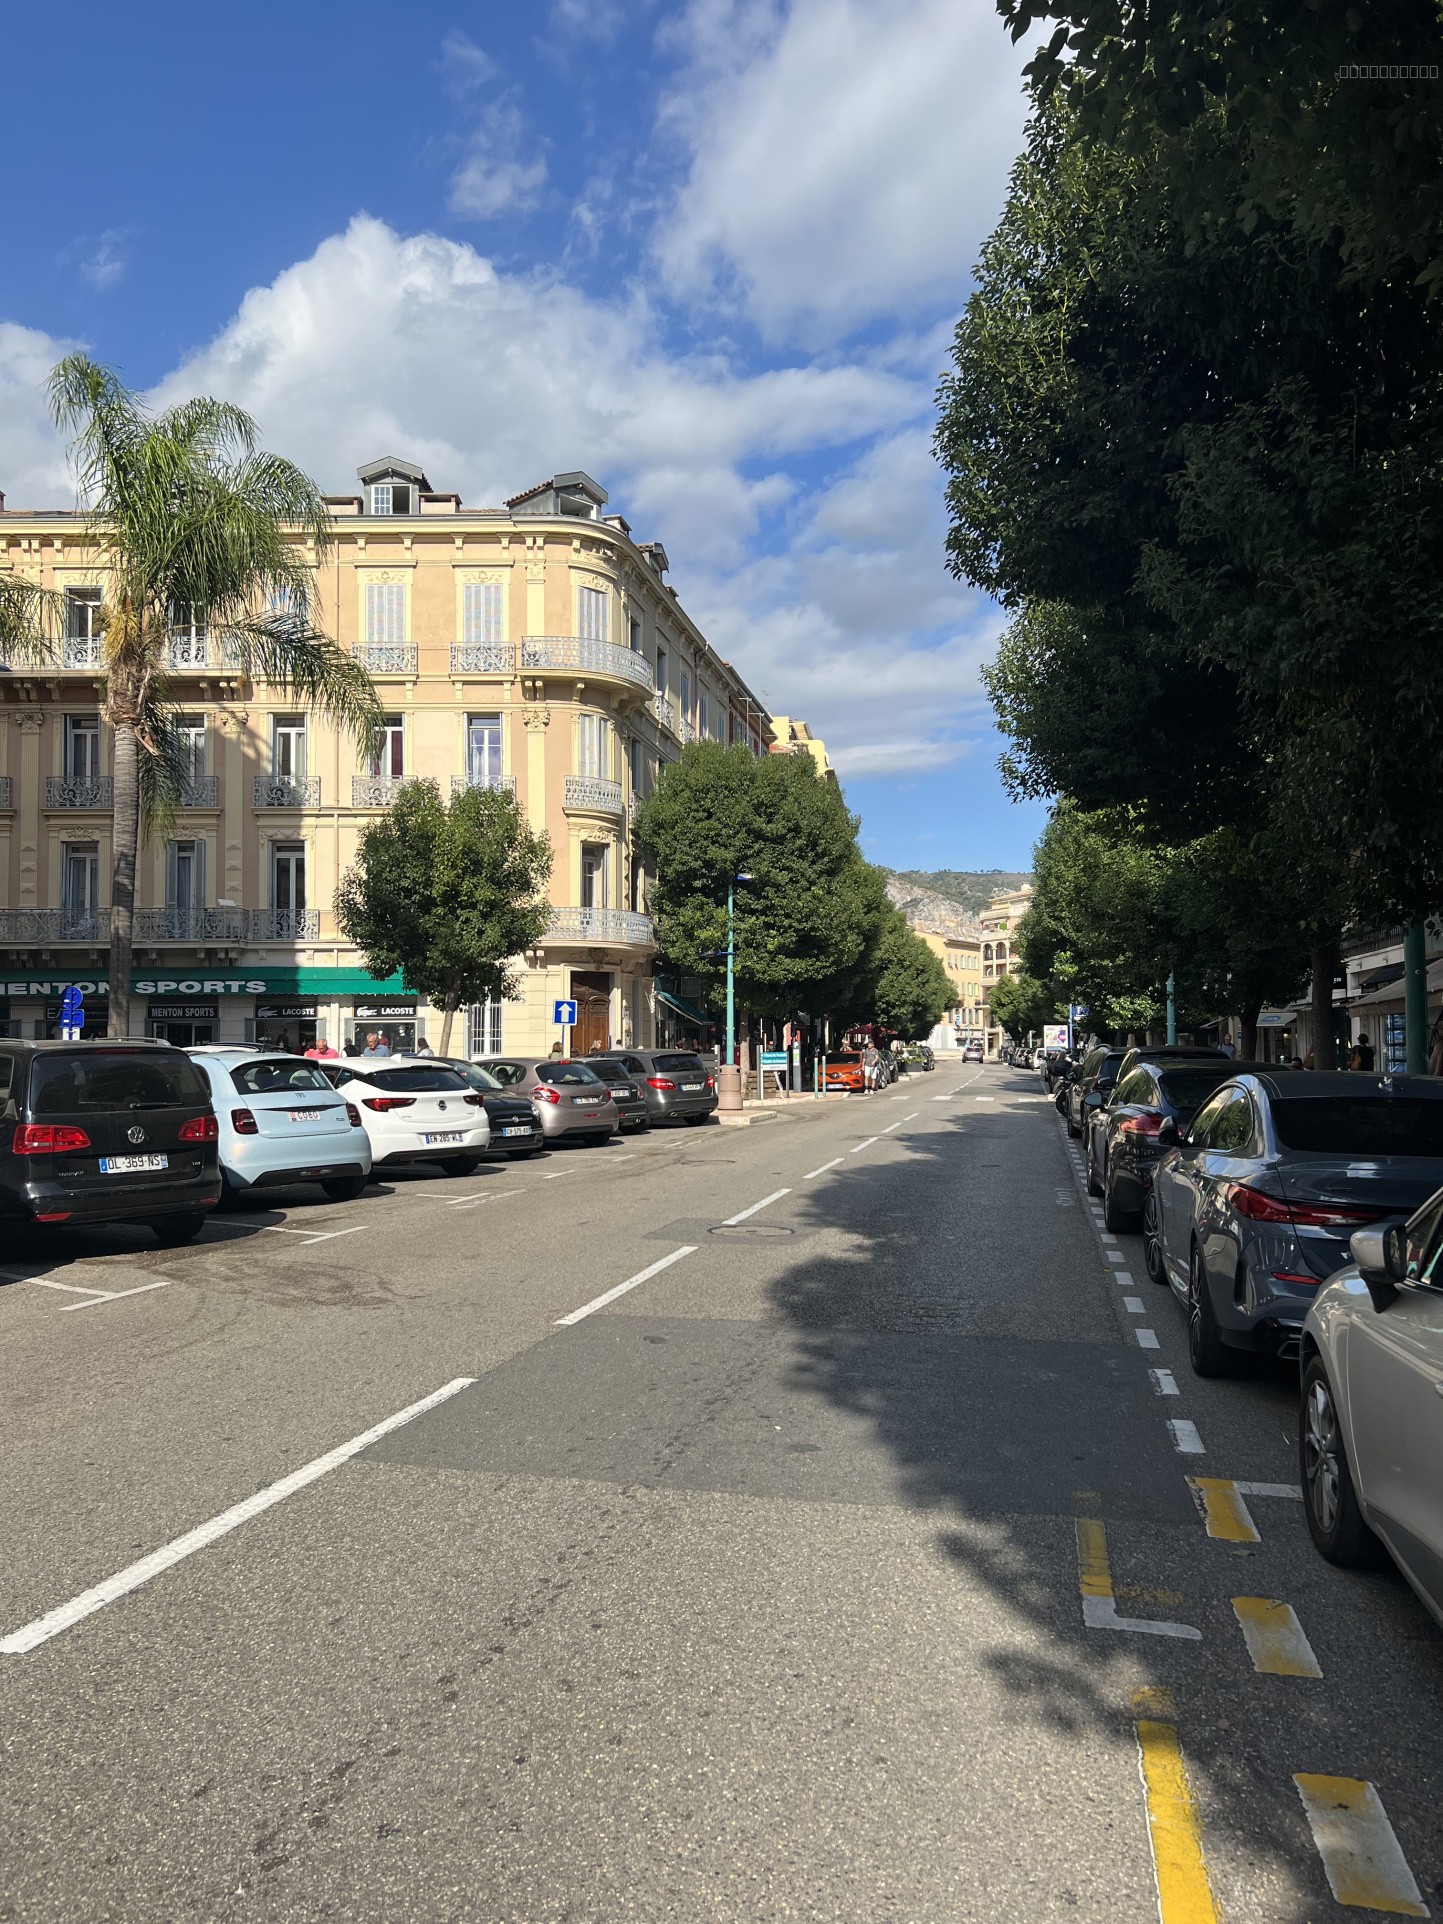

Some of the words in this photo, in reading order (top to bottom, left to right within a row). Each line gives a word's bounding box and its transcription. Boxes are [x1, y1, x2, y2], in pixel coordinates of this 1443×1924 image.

[135, 980, 267, 994] SPORTS
[151, 1007, 183, 1017] MENTON
[185, 1007, 215, 1017] SPORTS
[282, 1008, 315, 1016] LACOSTE
[381, 1007, 414, 1015] LACOSTE
